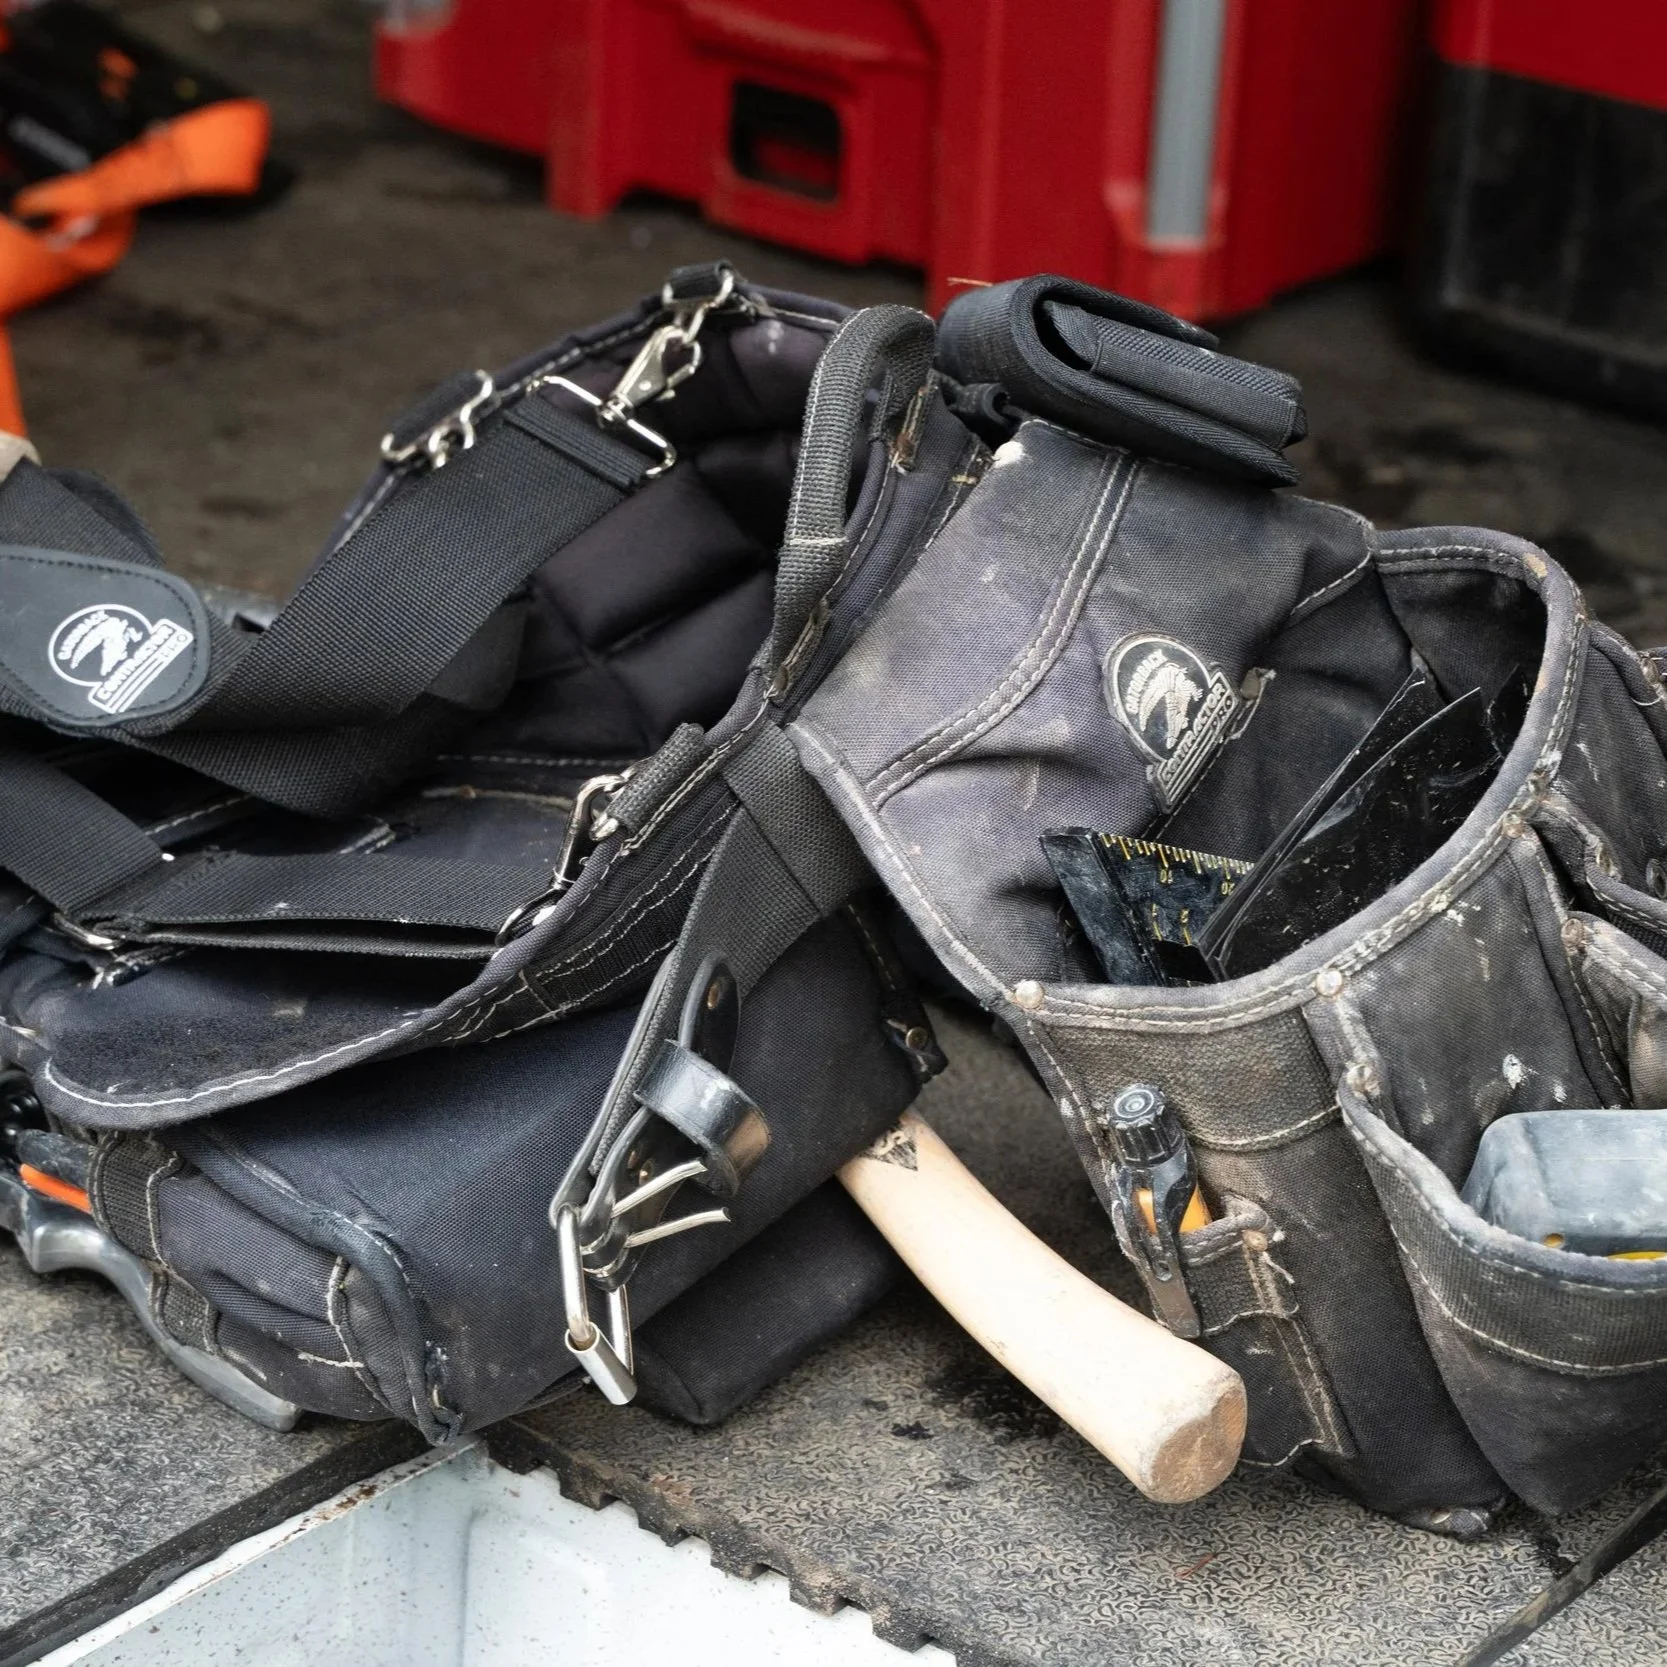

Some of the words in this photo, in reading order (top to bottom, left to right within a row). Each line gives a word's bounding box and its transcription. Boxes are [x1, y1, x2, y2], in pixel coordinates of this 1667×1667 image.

[96, 624, 174, 700] CONTRACTOR
[1125, 648, 1169, 715] GATORBACK
[1162, 682, 1227, 782] CONTRACTOR
[1209, 695, 1236, 732] PRO
